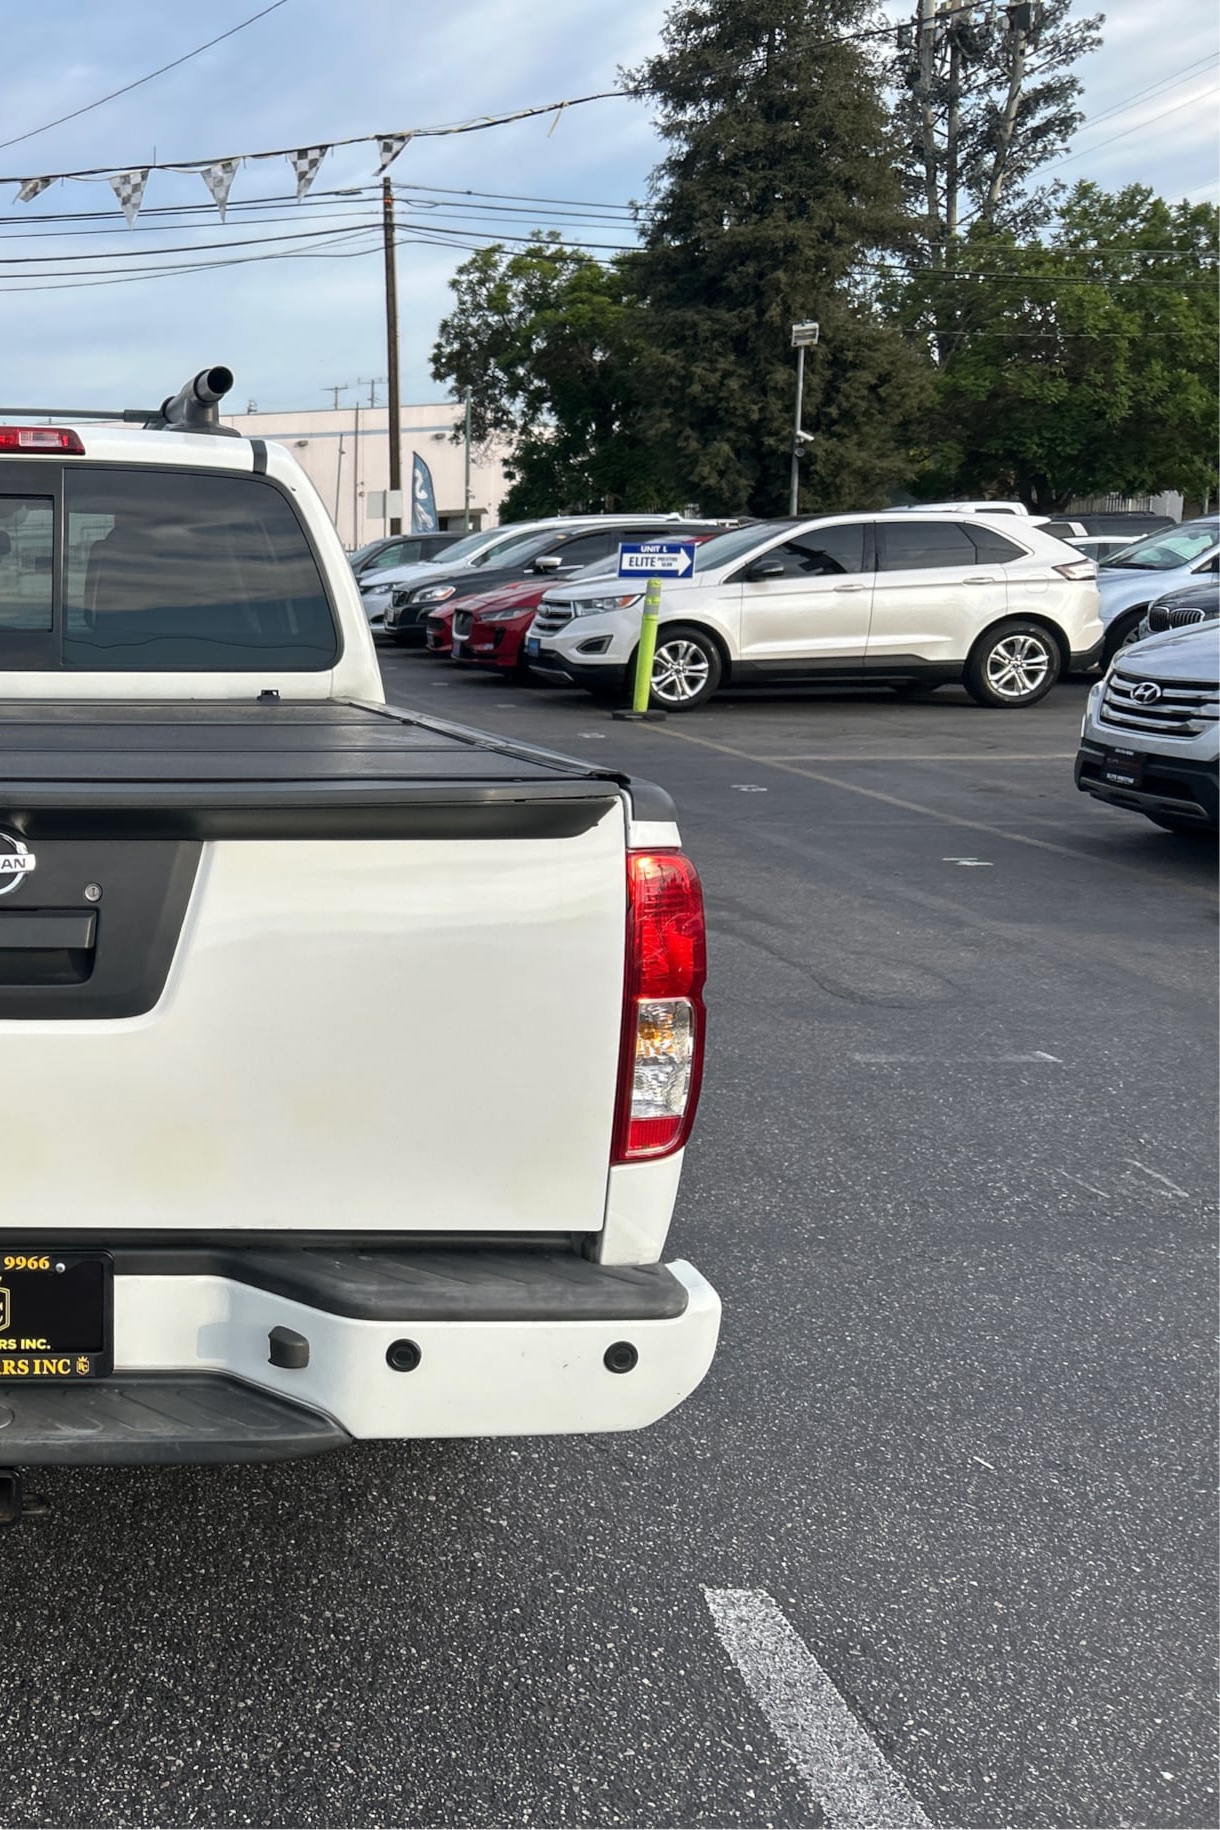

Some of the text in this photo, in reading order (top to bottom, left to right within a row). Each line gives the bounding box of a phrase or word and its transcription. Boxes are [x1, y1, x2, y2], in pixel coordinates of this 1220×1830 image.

[640, 545, 668, 553] UNIT L
[628, 556, 656, 567] ELITE
[4, 1256, 51, 1271] 9966
[20, 1339, 52, 1351] INC.
[33, 1359, 71, 1375] INC
